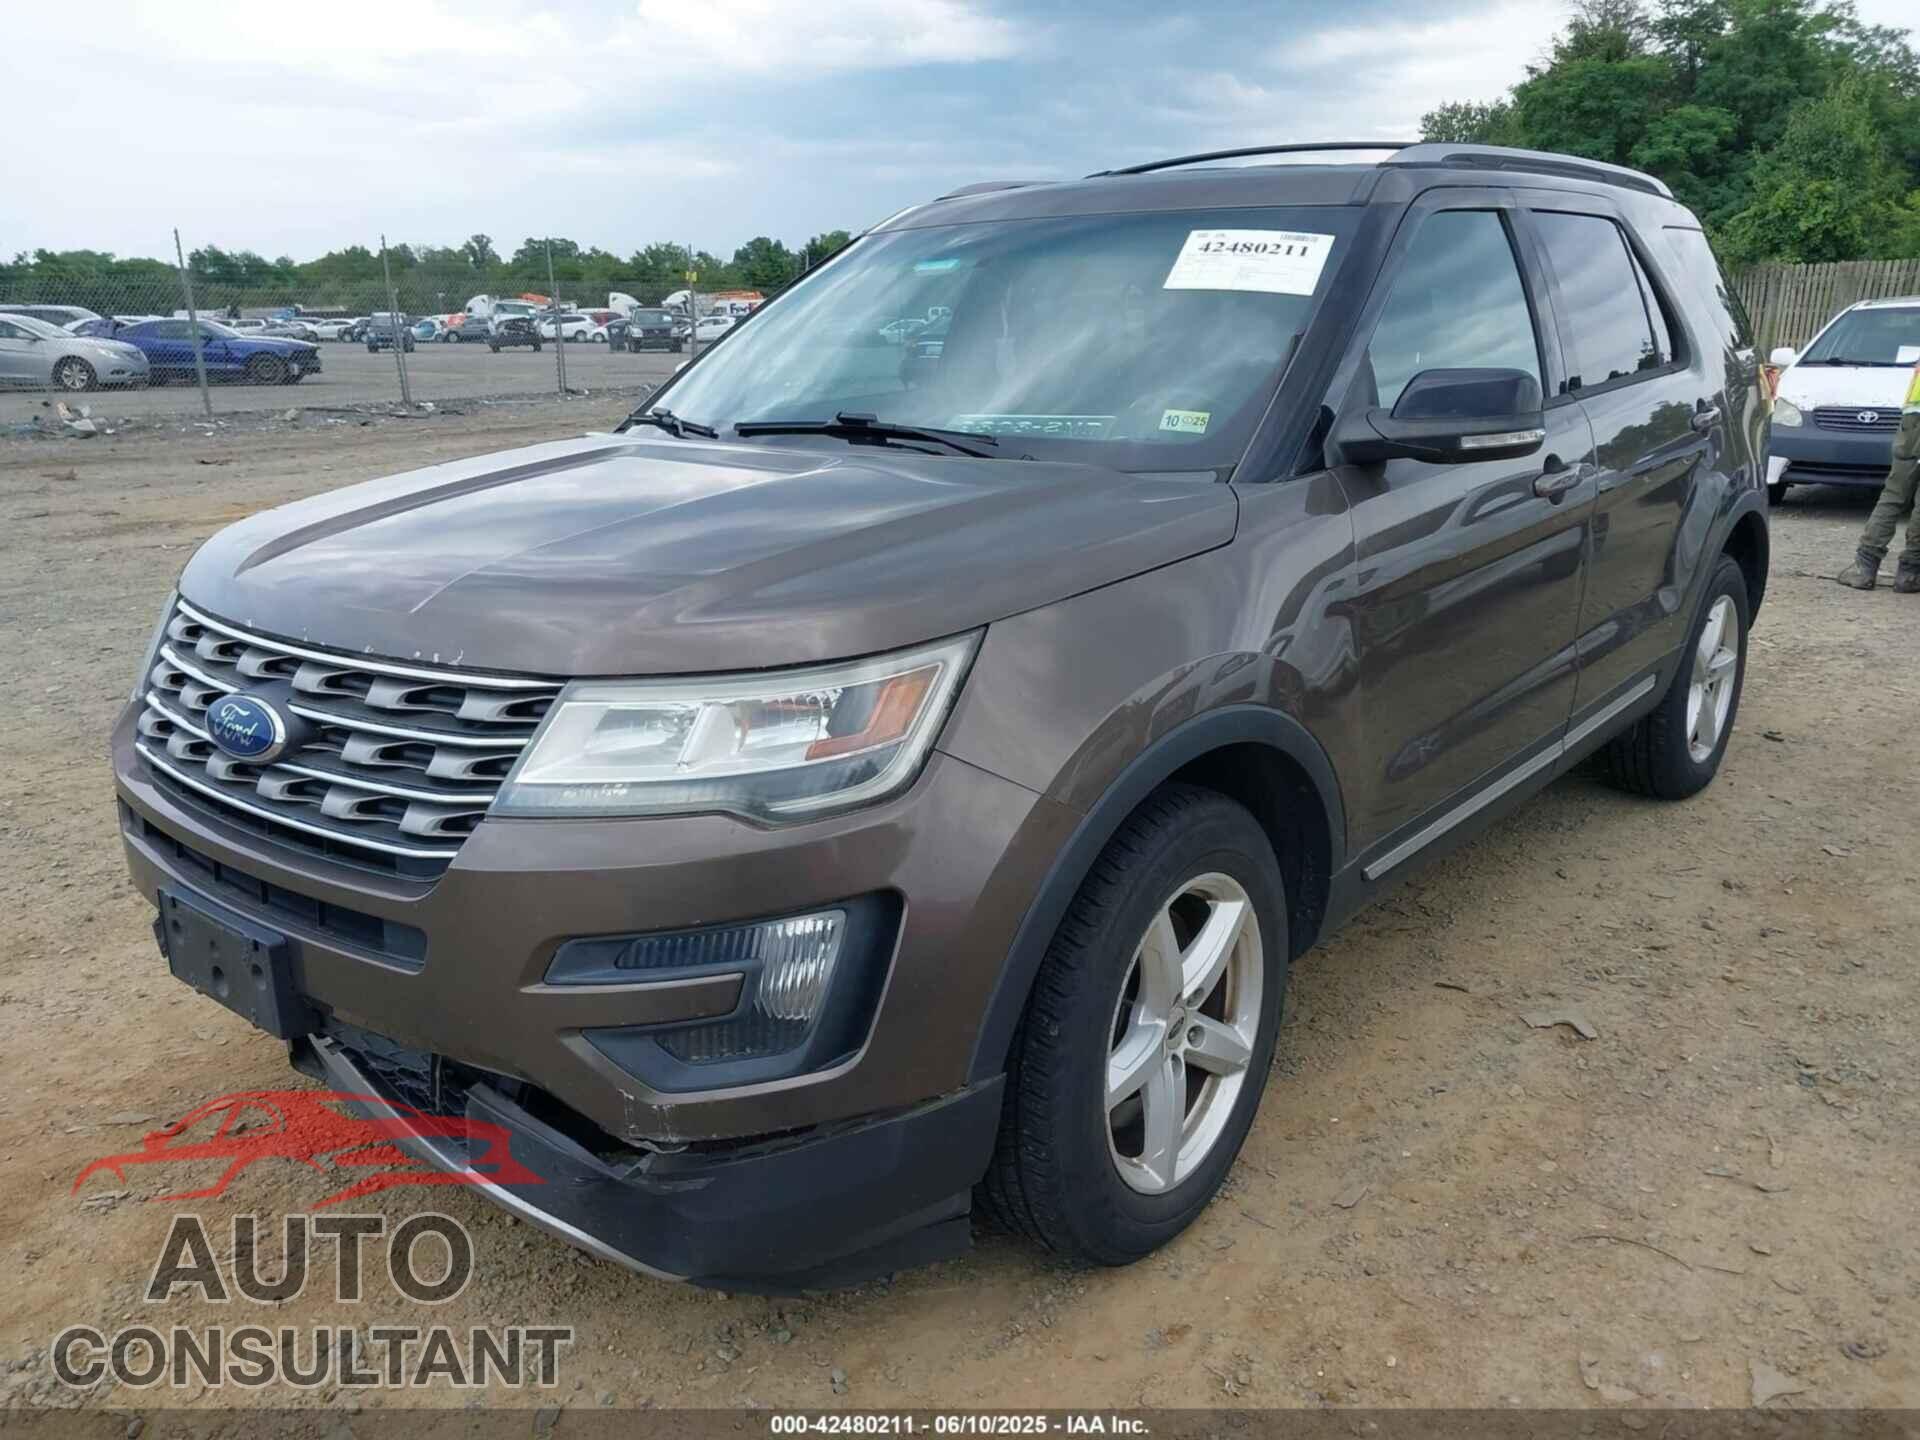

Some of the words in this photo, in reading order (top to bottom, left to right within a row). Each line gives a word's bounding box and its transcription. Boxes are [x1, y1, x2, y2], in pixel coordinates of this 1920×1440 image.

[1198, 241, 1309, 257] 42480211
[1166, 415, 1179, 427] 10
[1192, 416, 1206, 426] 25
[220, 703, 258, 735] Ford
